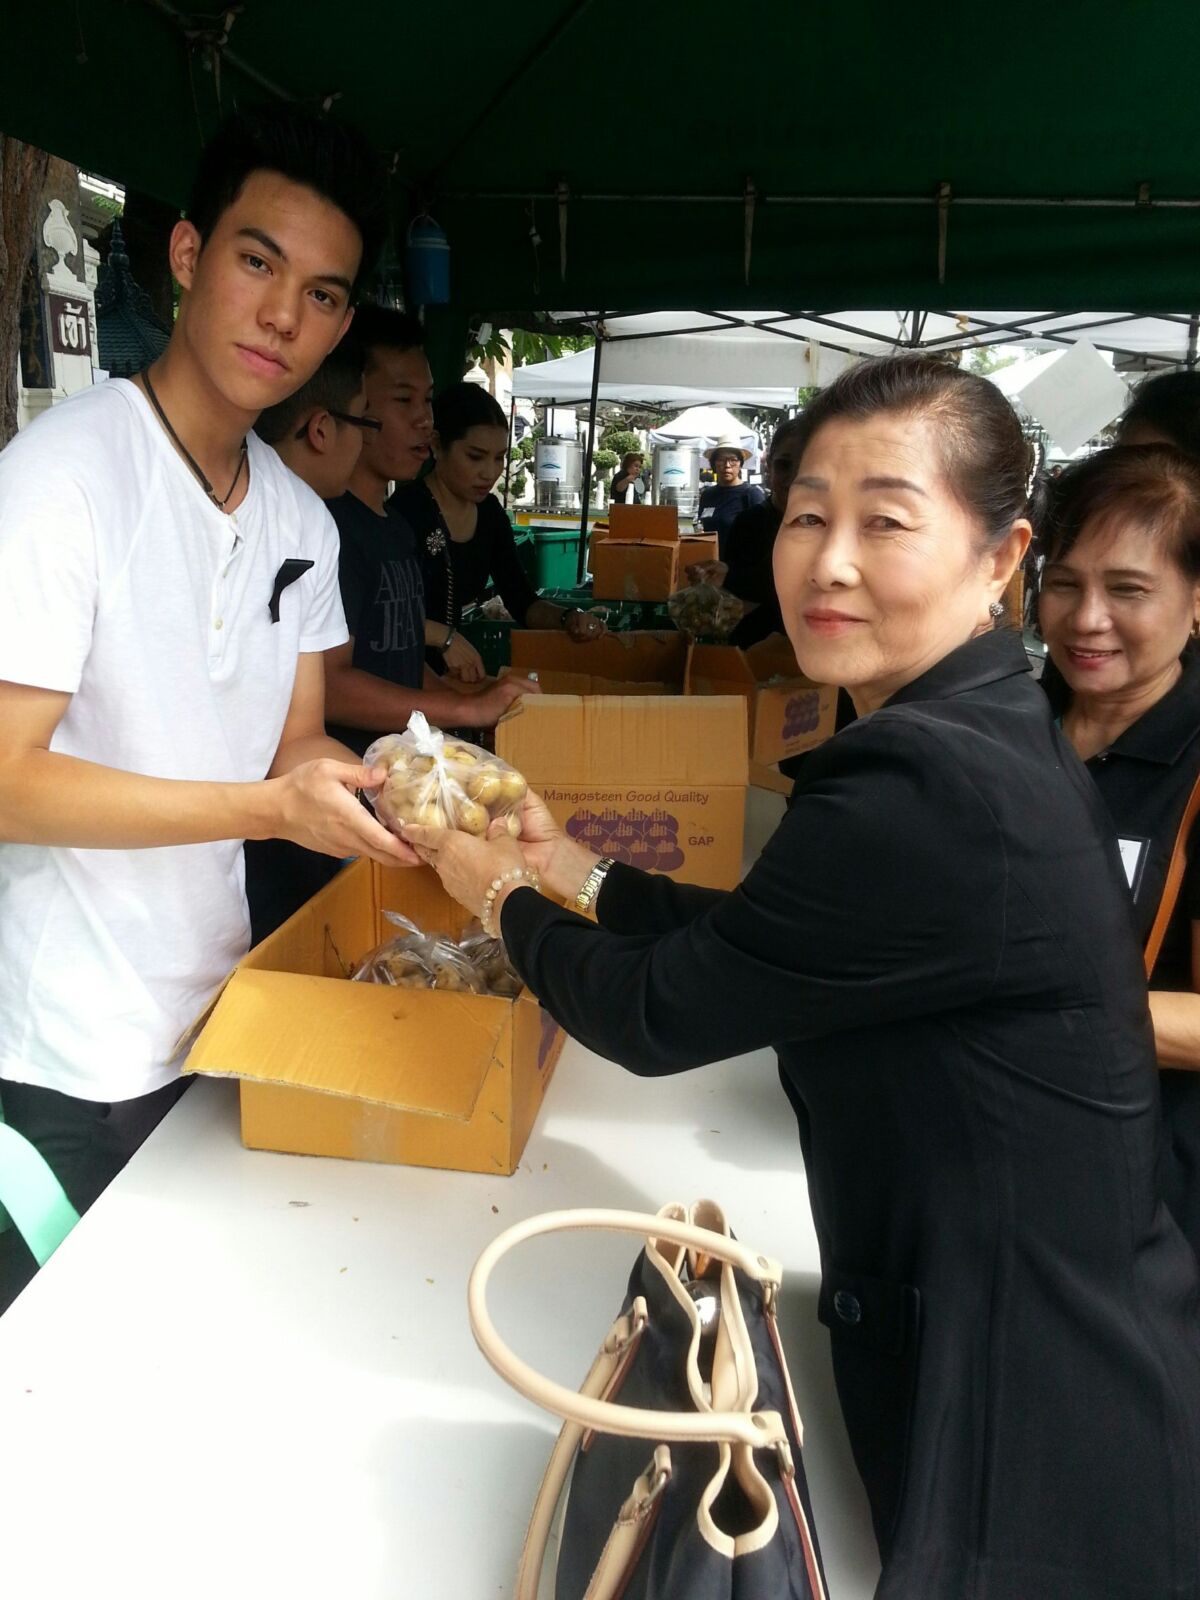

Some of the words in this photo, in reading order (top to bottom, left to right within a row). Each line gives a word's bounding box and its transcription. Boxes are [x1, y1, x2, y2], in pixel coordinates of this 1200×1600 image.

[59, 302, 87, 349] เข้า
[543, 789, 622, 804] Mangosteen
[625, 790, 661, 802] Good
[664, 790, 709, 805] Quality
[688, 836, 714, 846] GAP
